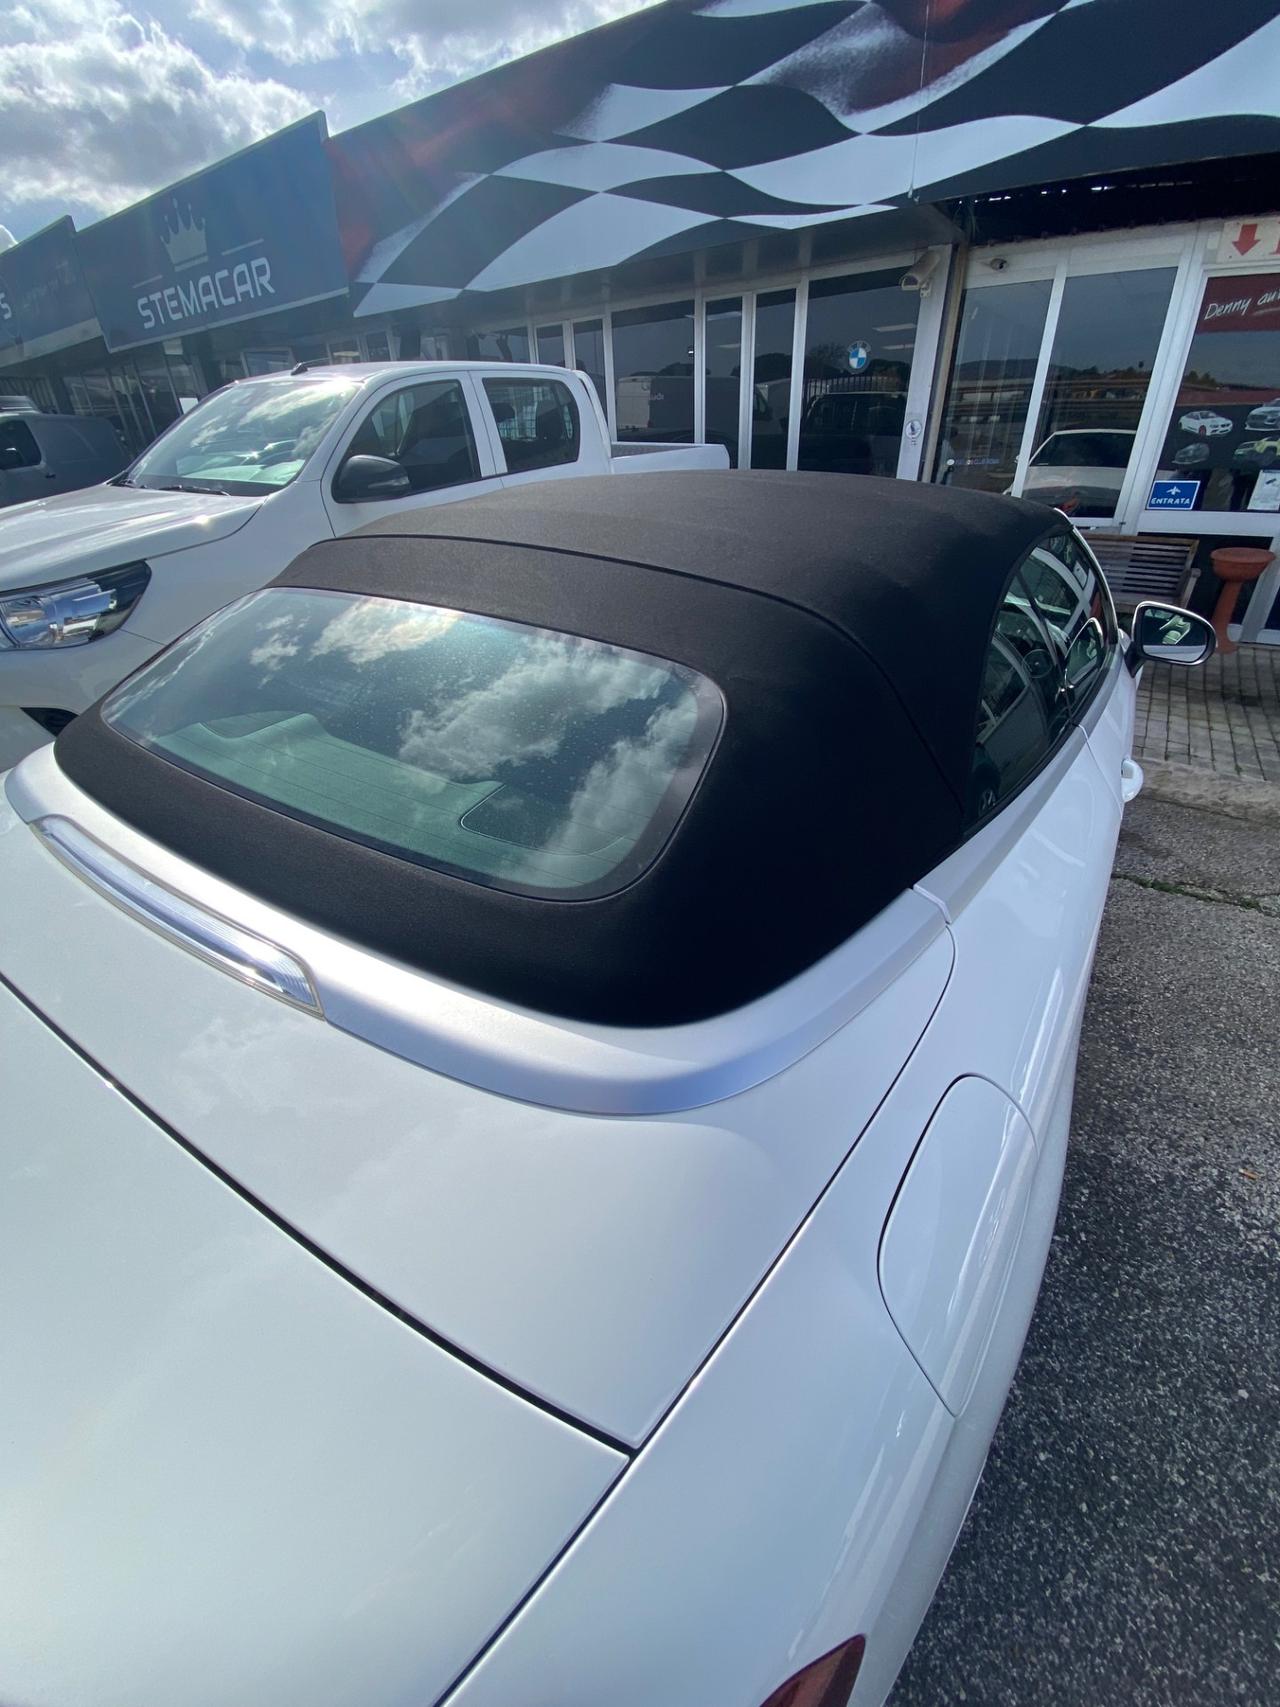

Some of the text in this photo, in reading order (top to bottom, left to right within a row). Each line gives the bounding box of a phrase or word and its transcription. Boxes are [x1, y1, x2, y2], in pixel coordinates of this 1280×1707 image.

[137, 257, 275, 329] STEMACAR
[1204, 298, 1252, 320] Denny
[1150, 497, 1190, 505] ENTRATA
